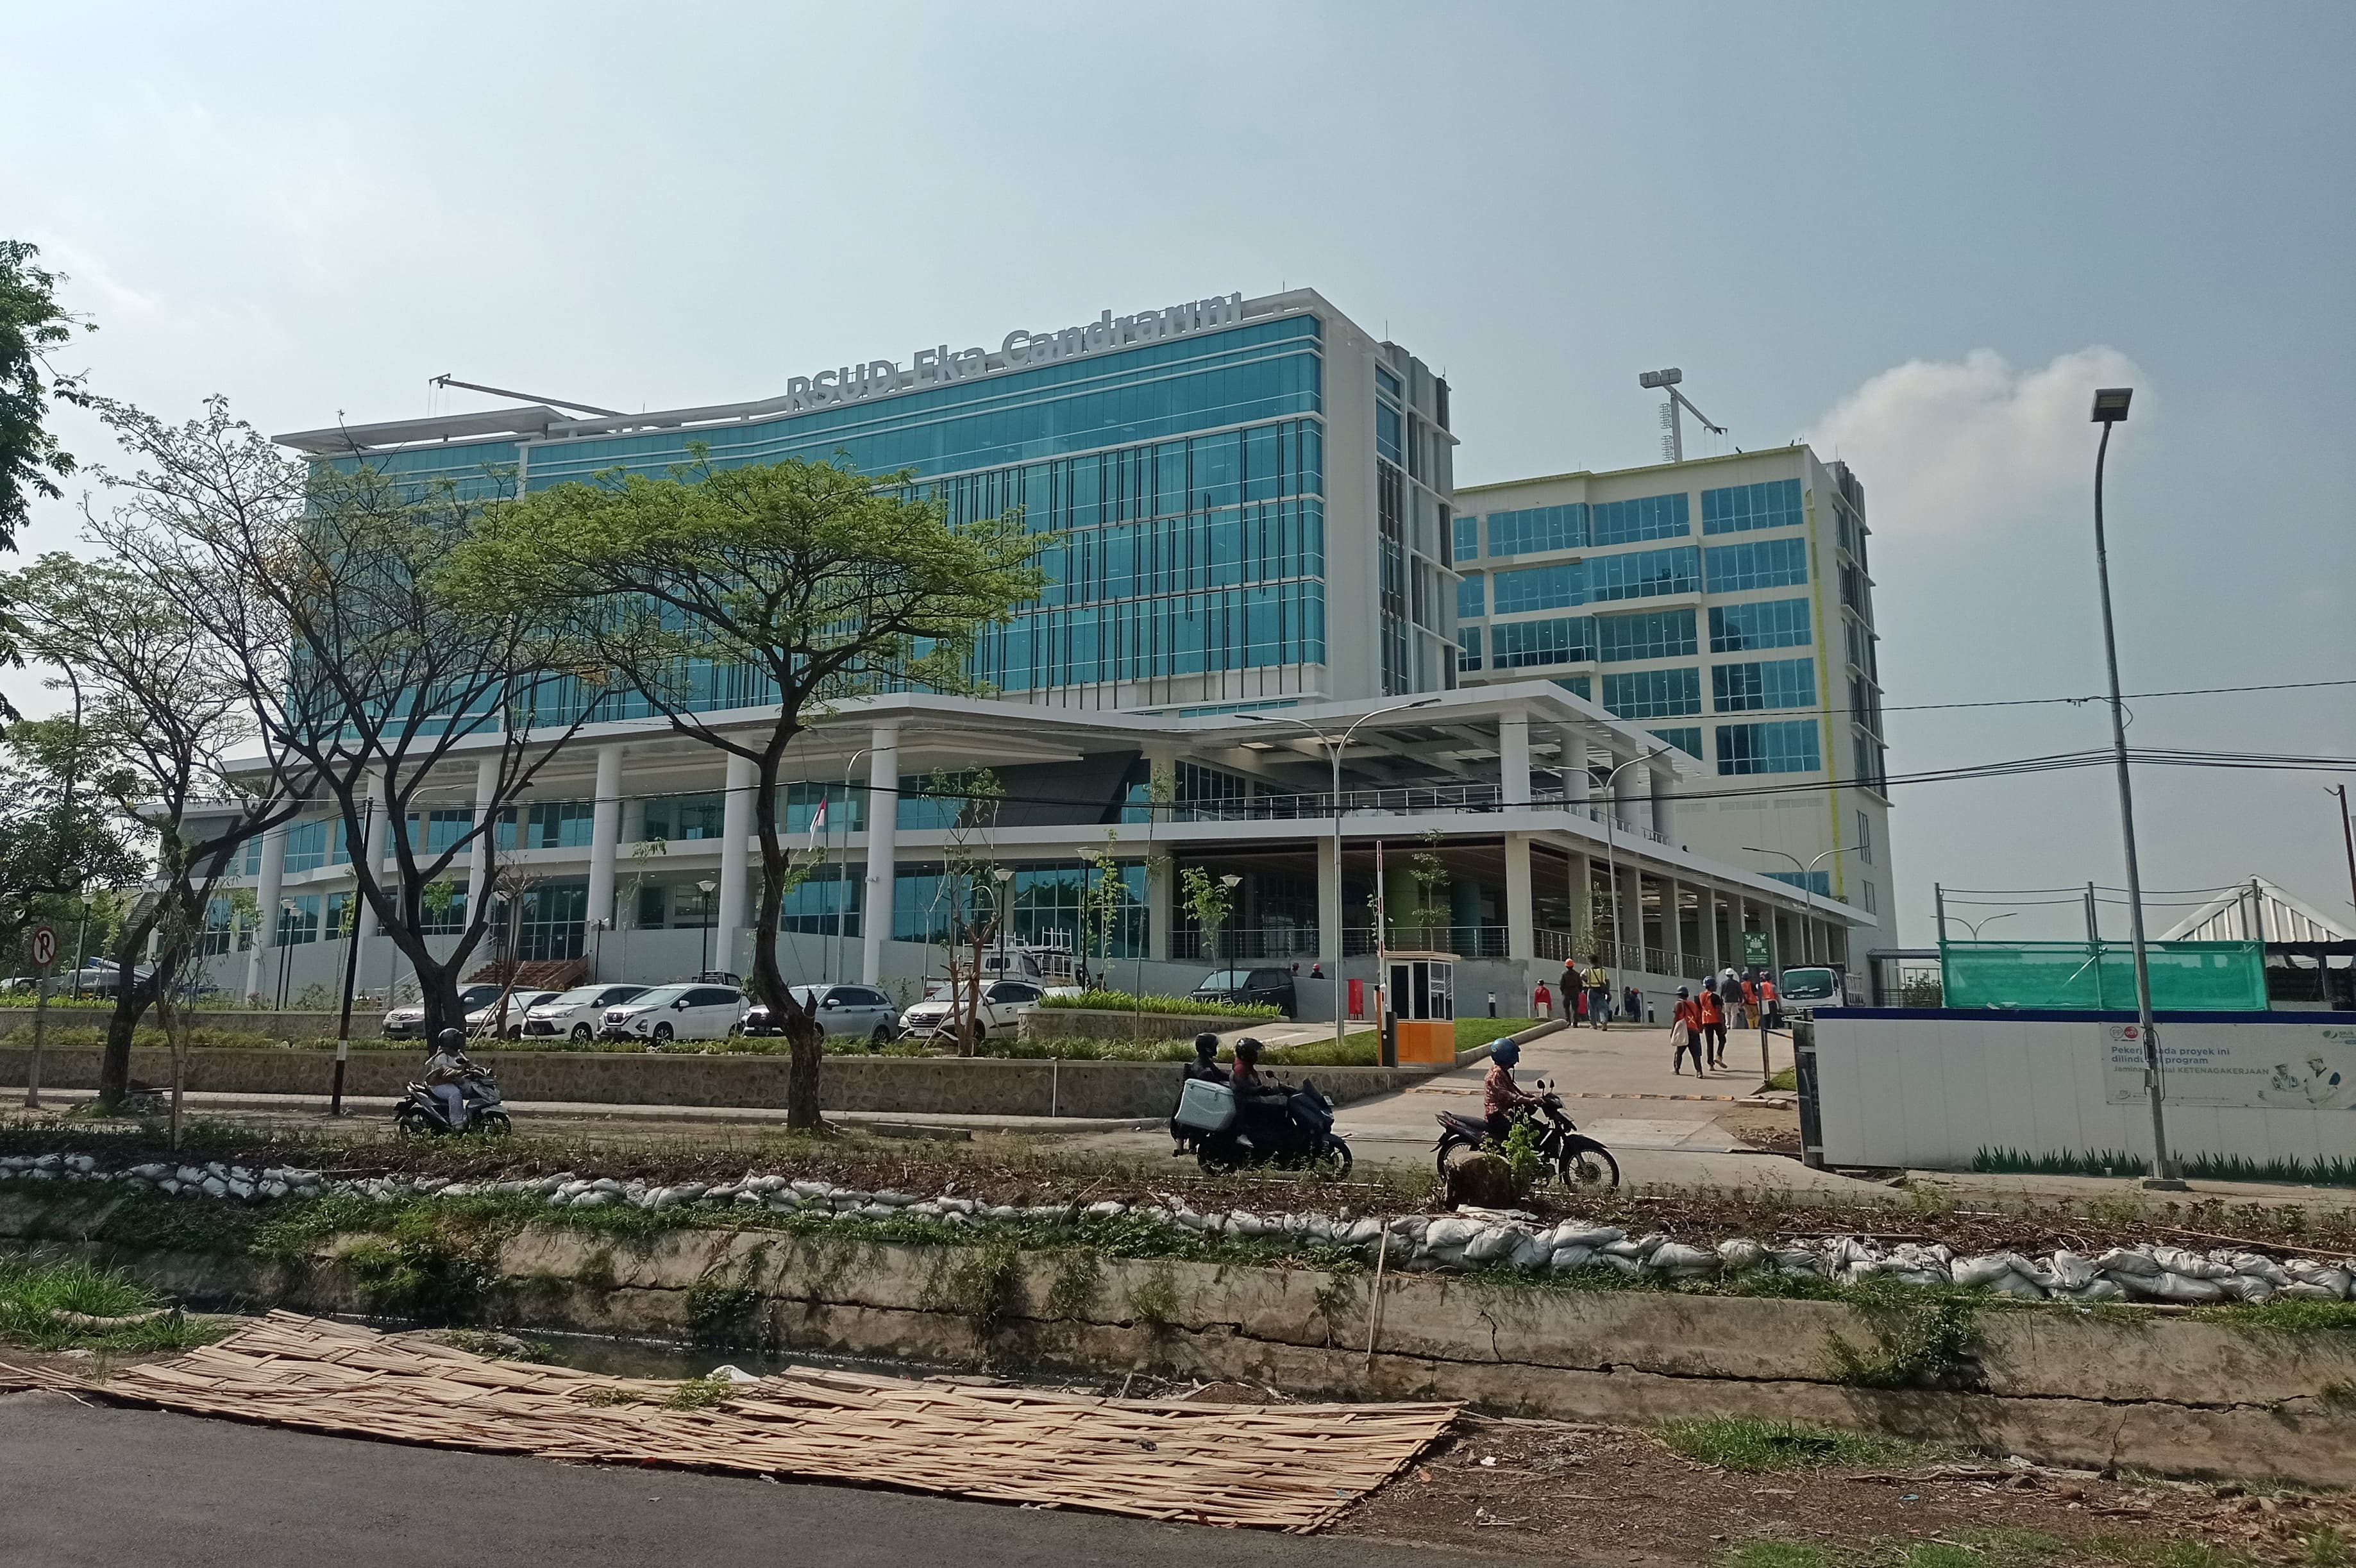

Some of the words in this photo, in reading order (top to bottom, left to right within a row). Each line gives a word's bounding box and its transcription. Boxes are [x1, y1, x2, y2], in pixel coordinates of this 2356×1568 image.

[786, 360, 896, 412] RSUD
[913, 344, 986, 386] Eka
[2112, 1047, 2146, 1055] Pekerj
[2180, 1048, 2214, 1056] proyek
[2165, 1057, 2209, 1065] program
